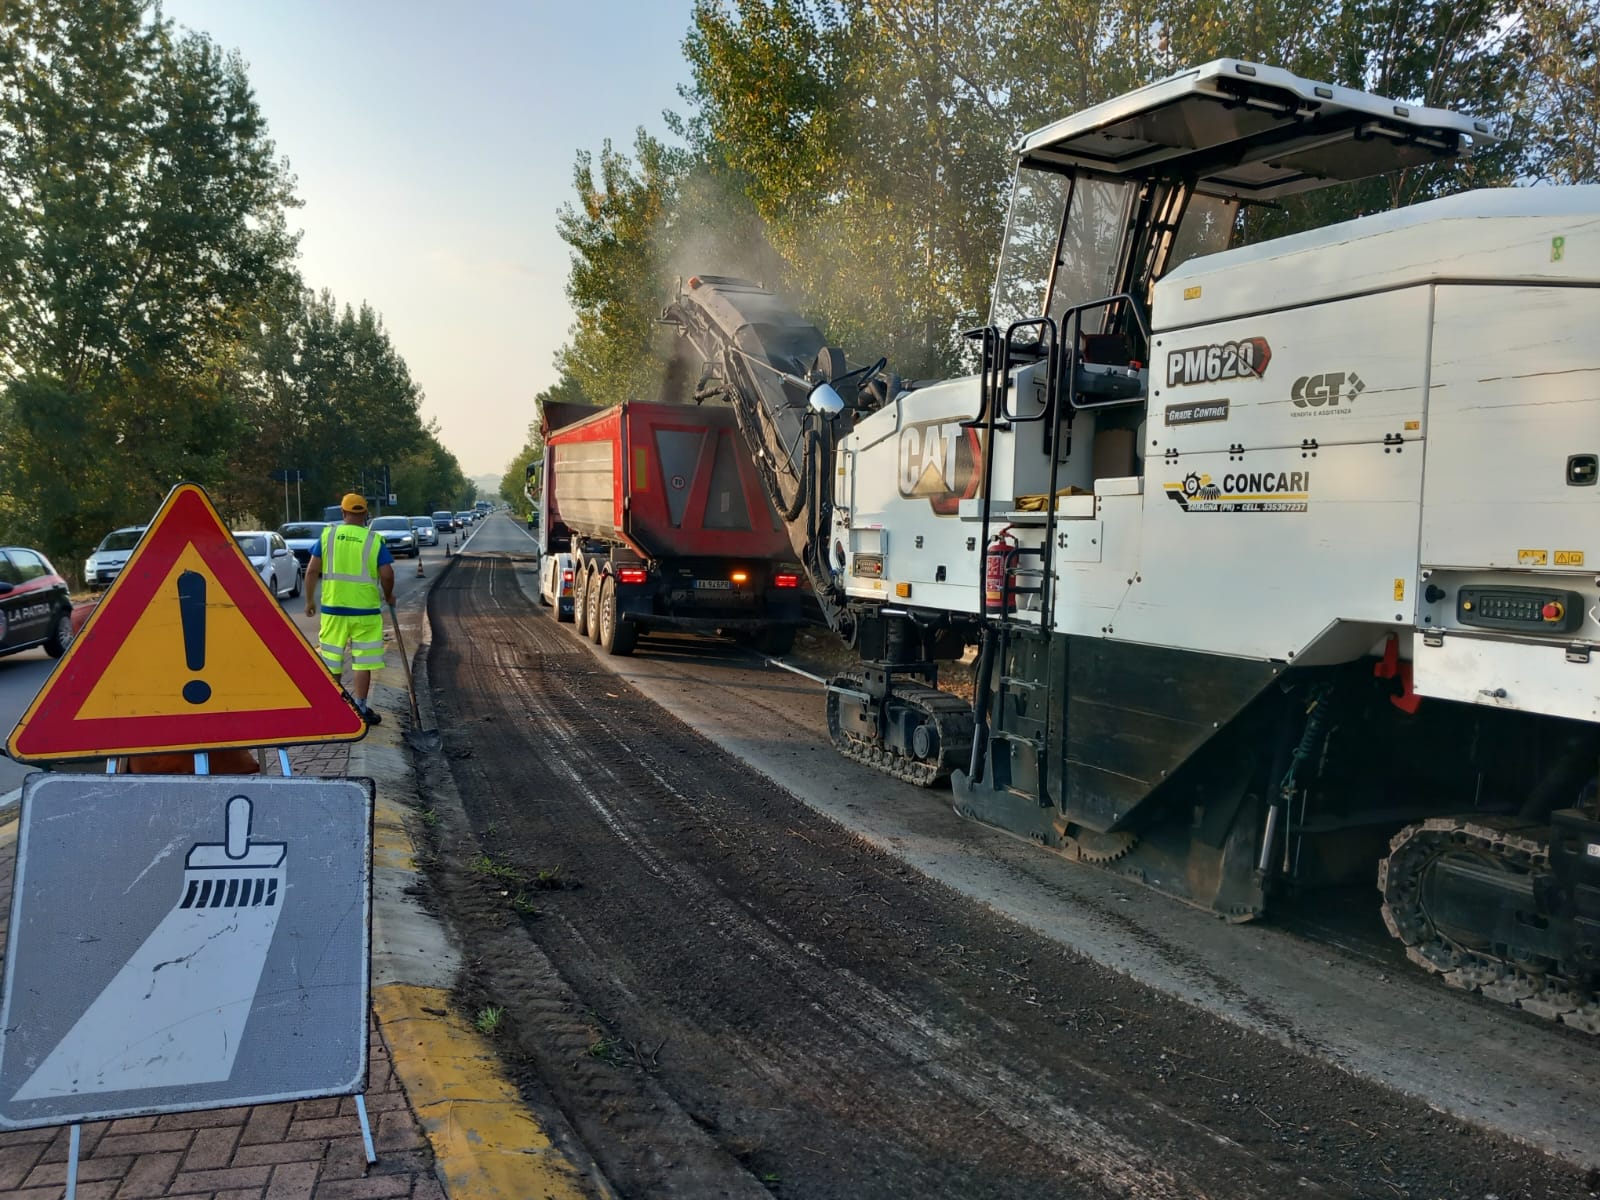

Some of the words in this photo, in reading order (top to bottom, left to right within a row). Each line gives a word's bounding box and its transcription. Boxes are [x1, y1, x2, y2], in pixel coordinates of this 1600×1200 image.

[1169, 342, 1254, 385] PM620
[1291, 372, 1345, 408] CGT
[1168, 409, 1193, 421] GRADE
[1193, 406, 1225, 418] CONTROL
[900, 422, 962, 494] CAT
[1223, 471, 1310, 493] CONCARI
[8, 609, 21, 622] LA
